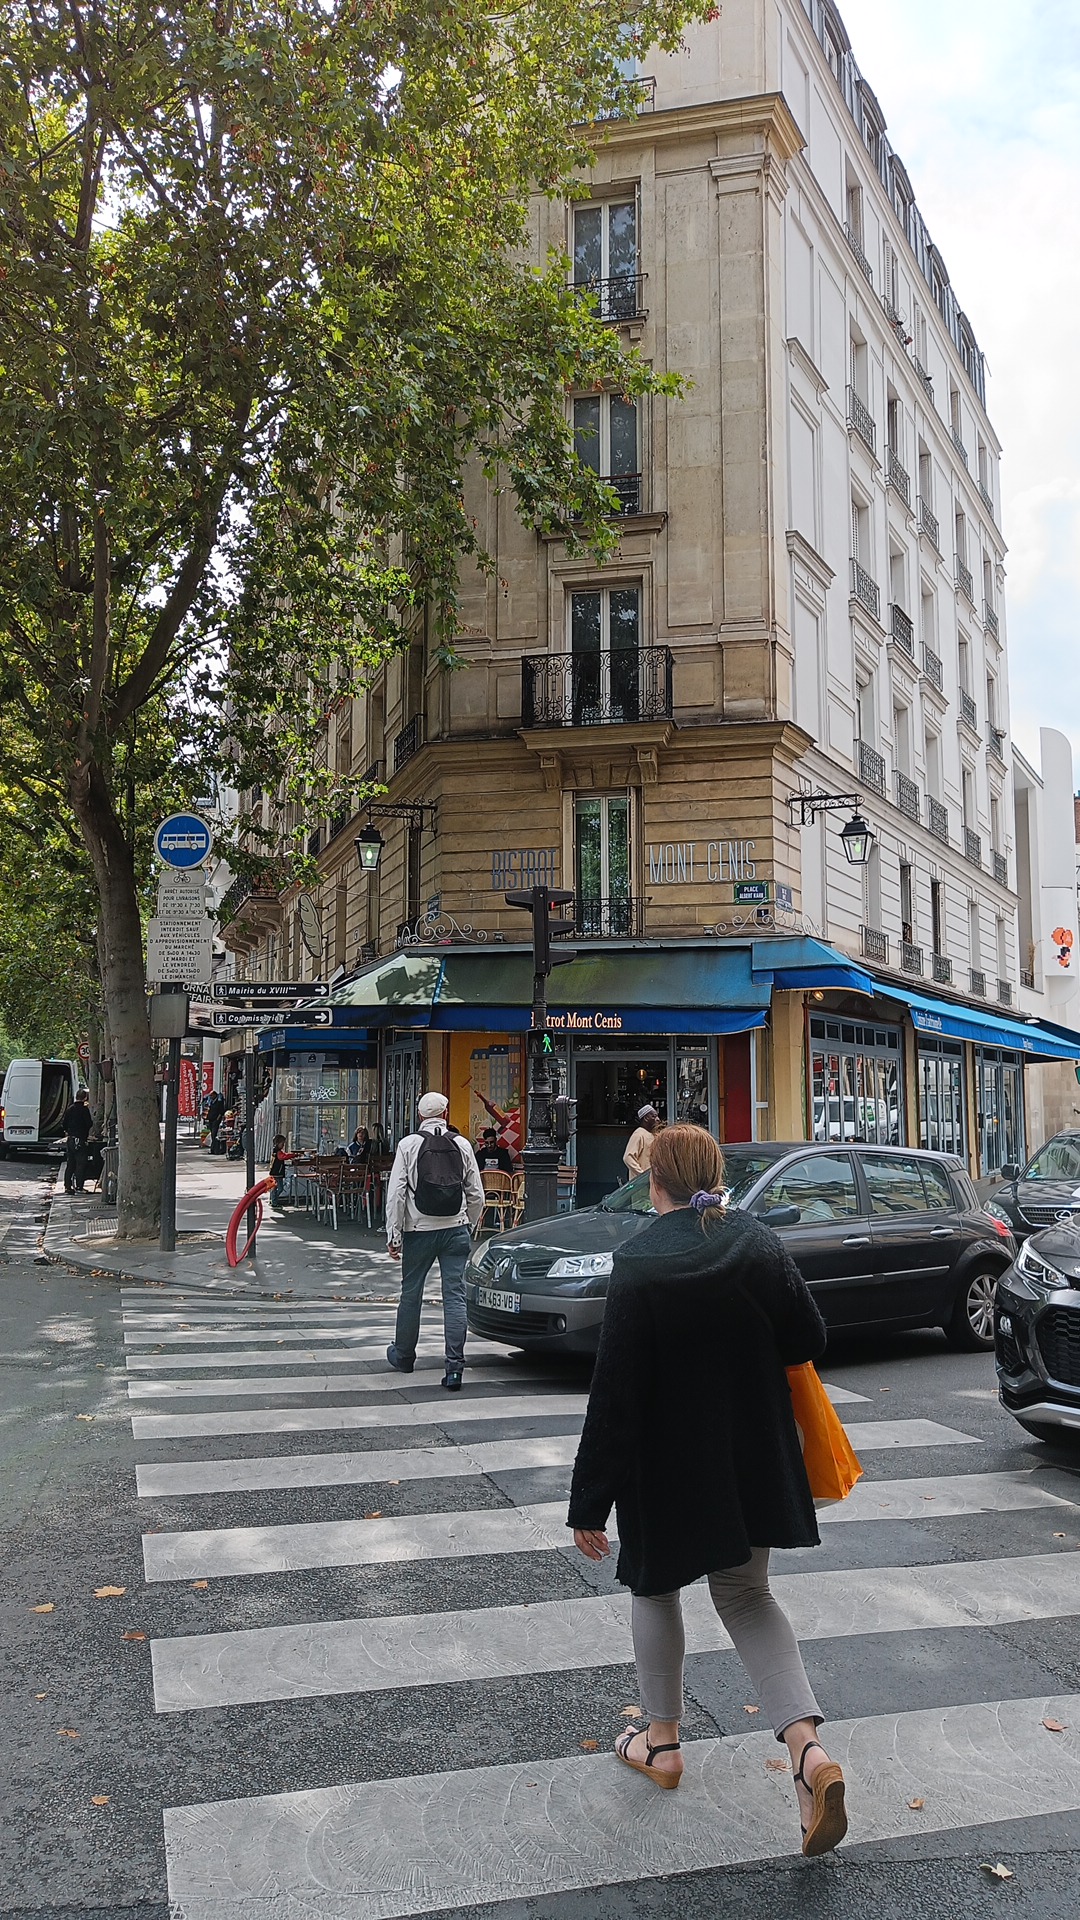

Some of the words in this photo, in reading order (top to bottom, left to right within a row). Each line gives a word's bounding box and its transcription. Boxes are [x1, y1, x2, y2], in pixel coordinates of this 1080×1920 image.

[492, 848, 556, 889] BISTROT
[566, 1012, 592, 1028] Mont
[594, 1012, 622, 1028] Cenis
